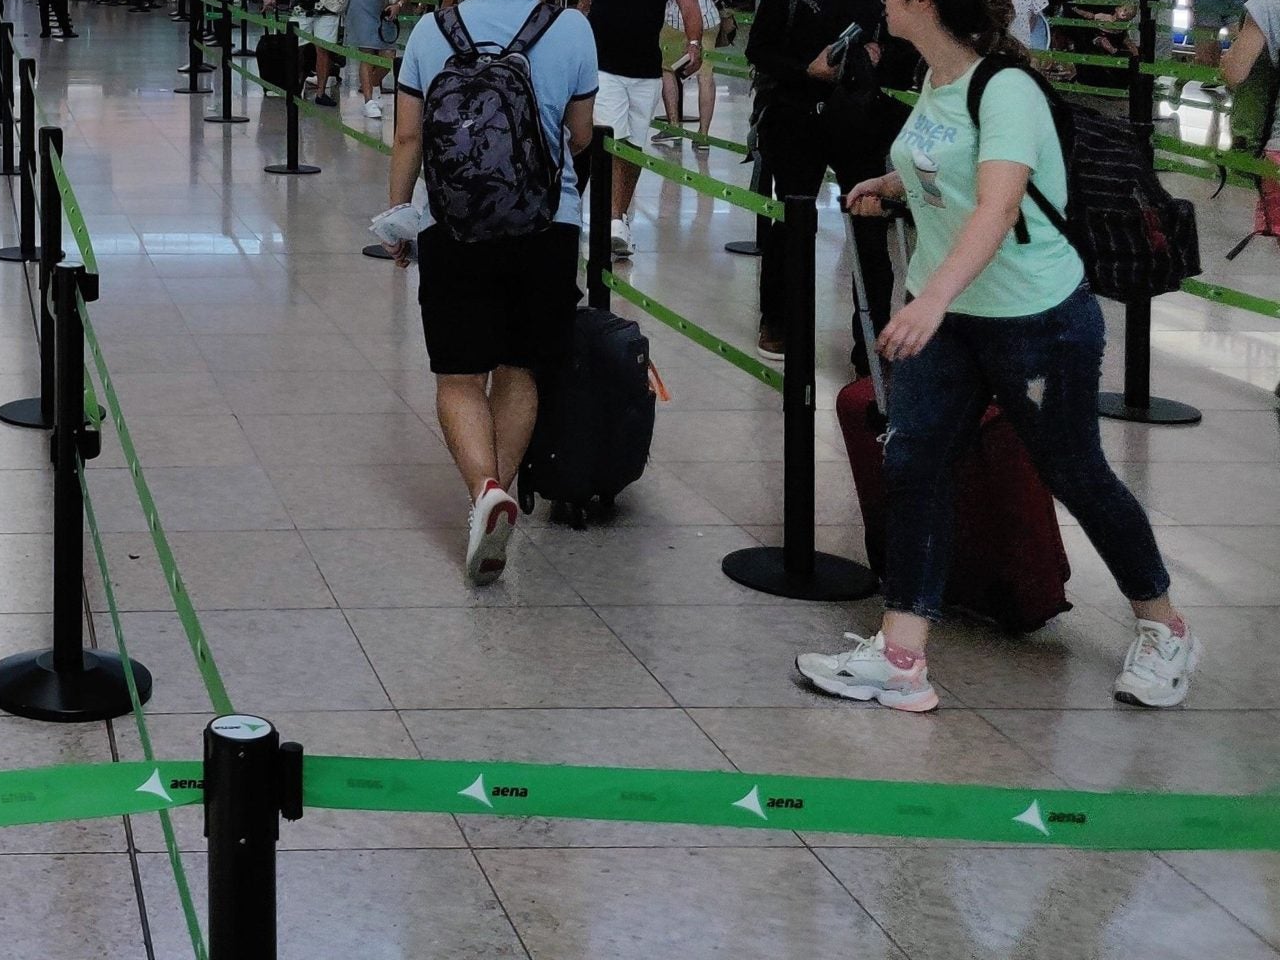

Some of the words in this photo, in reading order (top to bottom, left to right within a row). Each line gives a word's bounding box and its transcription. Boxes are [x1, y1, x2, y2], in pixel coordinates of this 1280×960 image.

[170, 778, 206, 790] aena
[492, 786, 528, 798] aena
[766, 797, 804, 809] aena
[1048, 811, 1087, 824] aena
